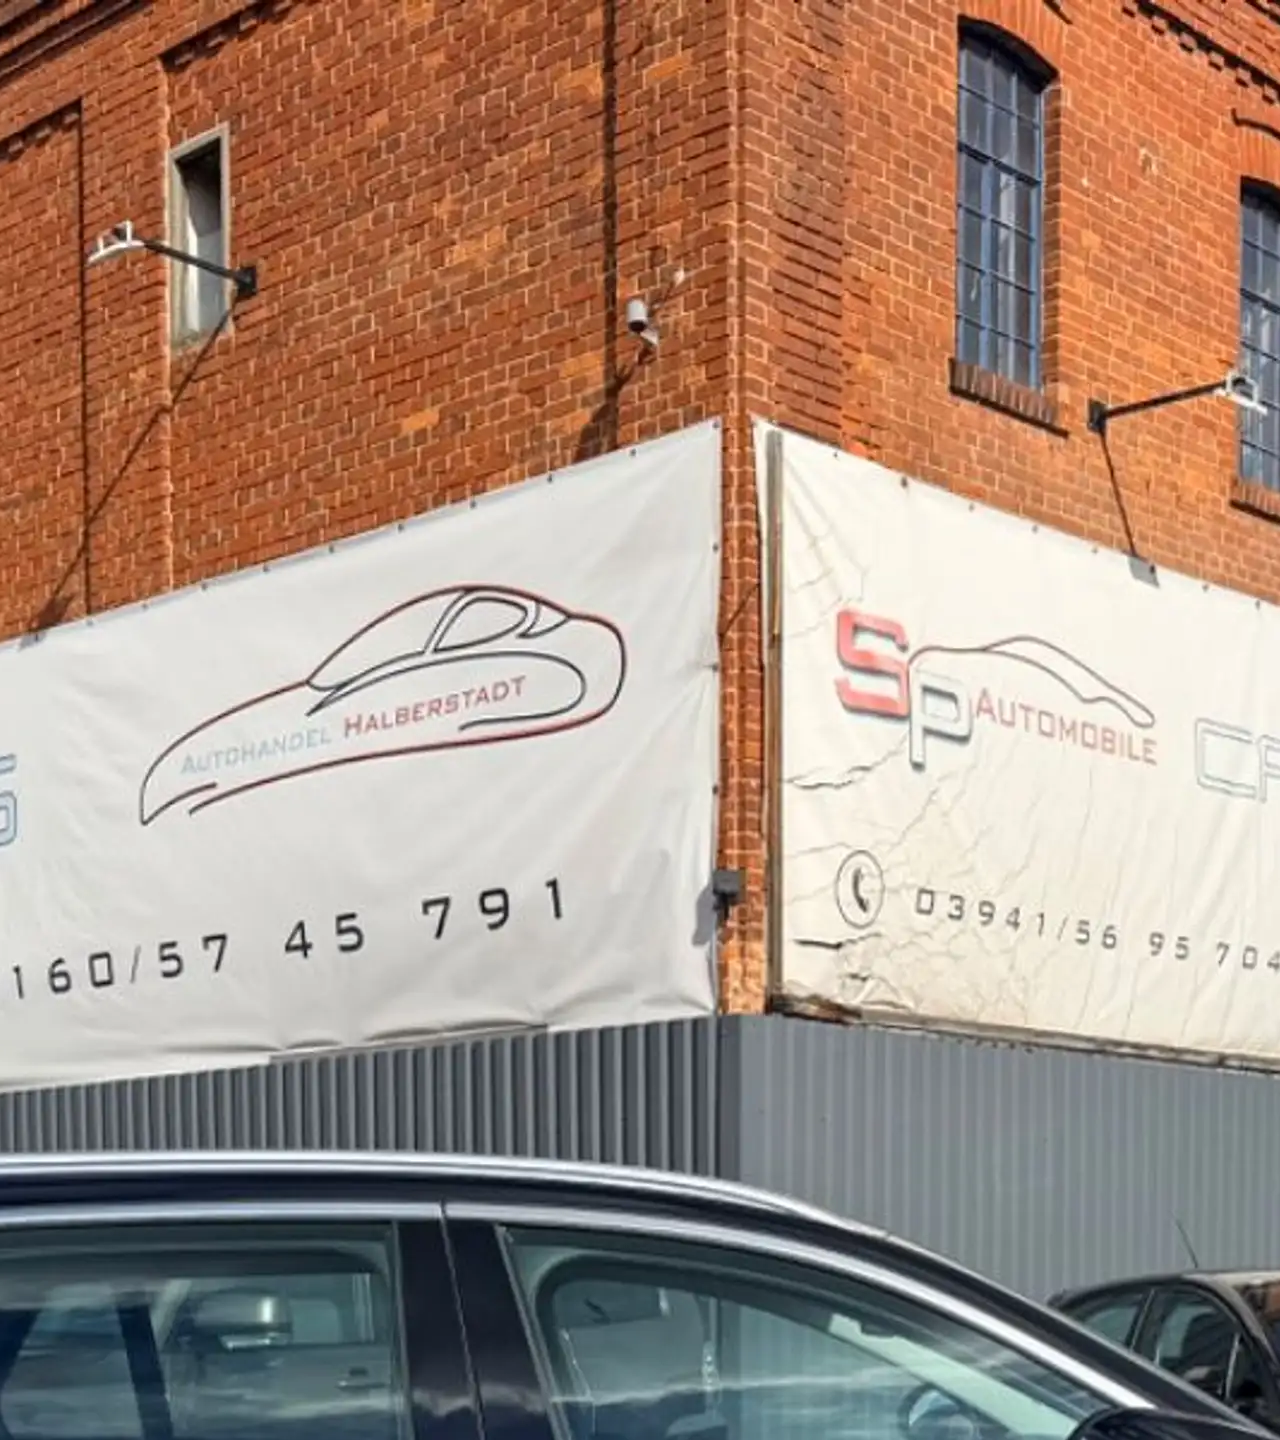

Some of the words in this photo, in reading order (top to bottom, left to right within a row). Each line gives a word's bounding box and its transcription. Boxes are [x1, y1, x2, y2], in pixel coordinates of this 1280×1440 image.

[284, 911, 365, 959] 45
[422, 878, 563, 940] 791
[1148, 931, 1190, 961] 95
